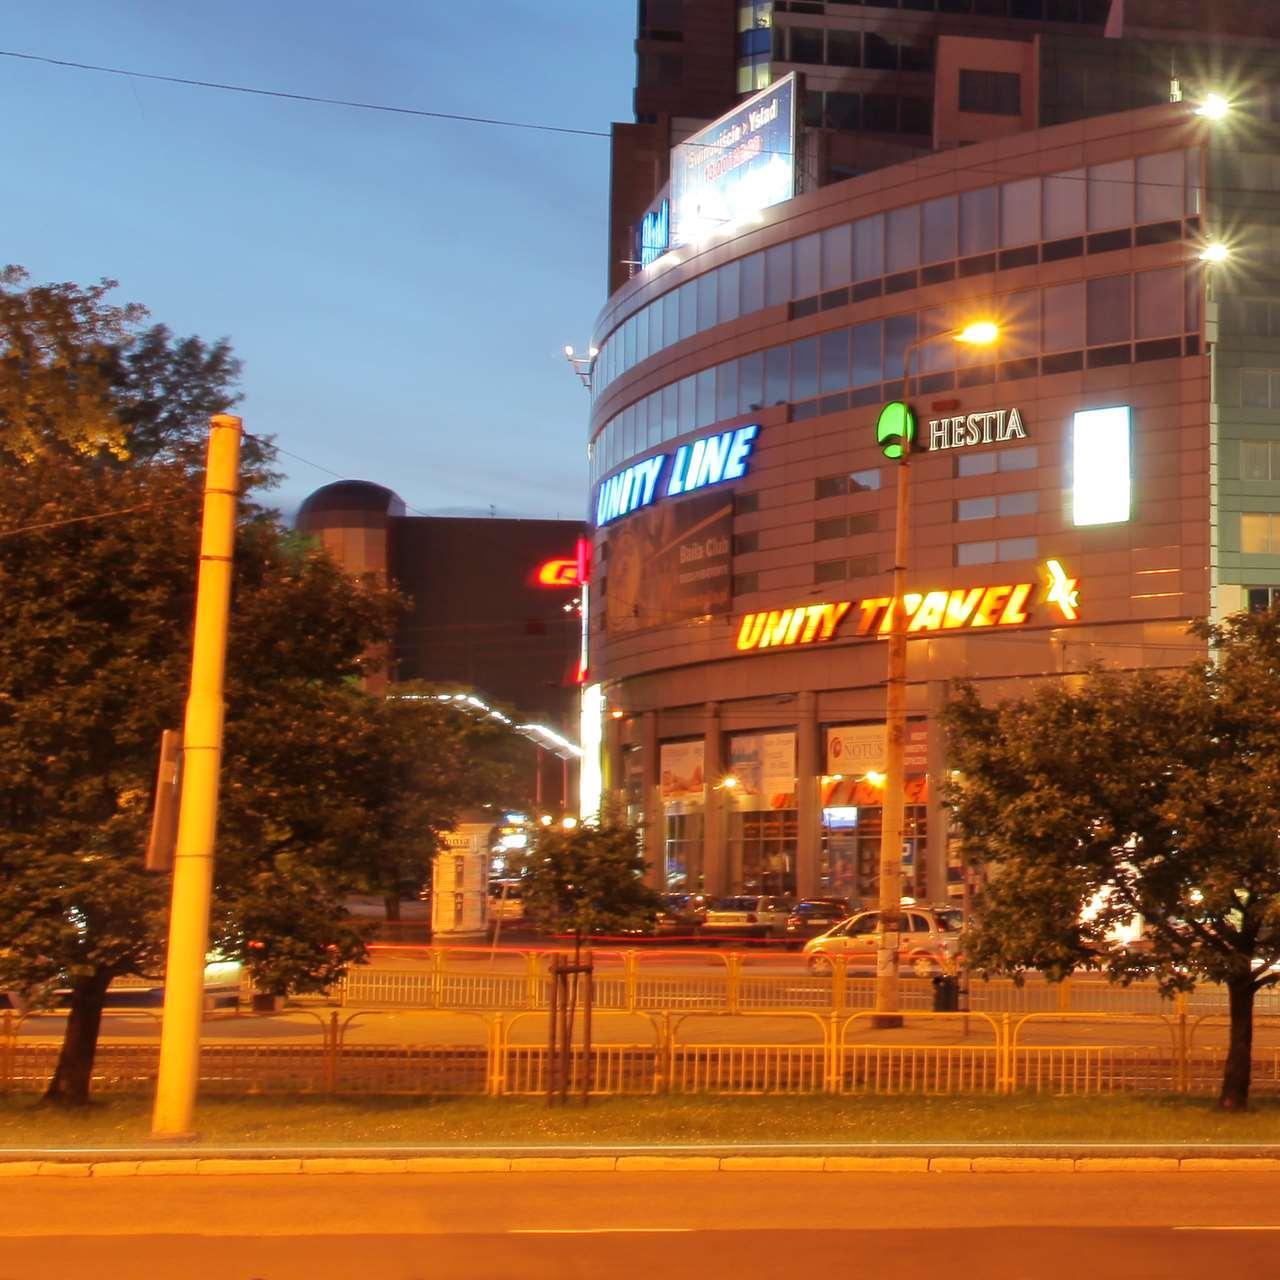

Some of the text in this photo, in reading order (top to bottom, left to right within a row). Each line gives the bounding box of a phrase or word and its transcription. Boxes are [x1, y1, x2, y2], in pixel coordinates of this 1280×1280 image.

[929, 408, 1026, 451] HESTIA
[597, 424, 760, 527] UNITY LINE
[736, 601, 851, 651] UNITY
